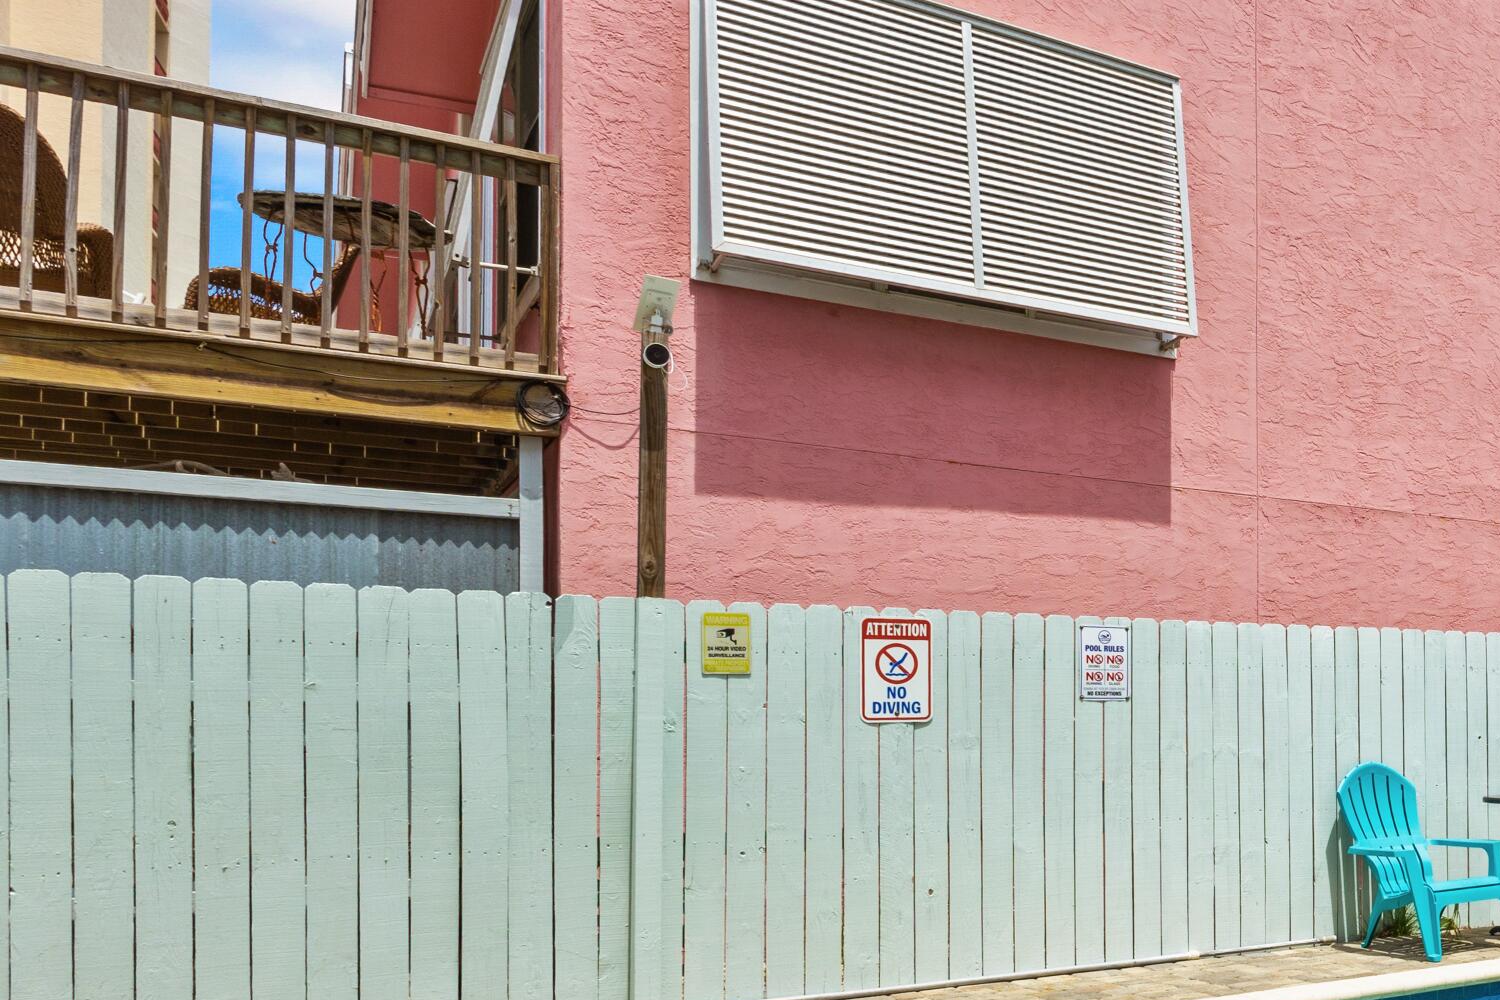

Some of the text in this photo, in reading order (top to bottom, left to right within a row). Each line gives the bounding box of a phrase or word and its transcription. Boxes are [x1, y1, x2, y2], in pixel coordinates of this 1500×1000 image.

[706, 616, 747, 624] WARNING
[866, 622, 927, 637] ATTENTION
[887, 686, 907, 699] NO
[872, 701, 921, 714] DIVING
